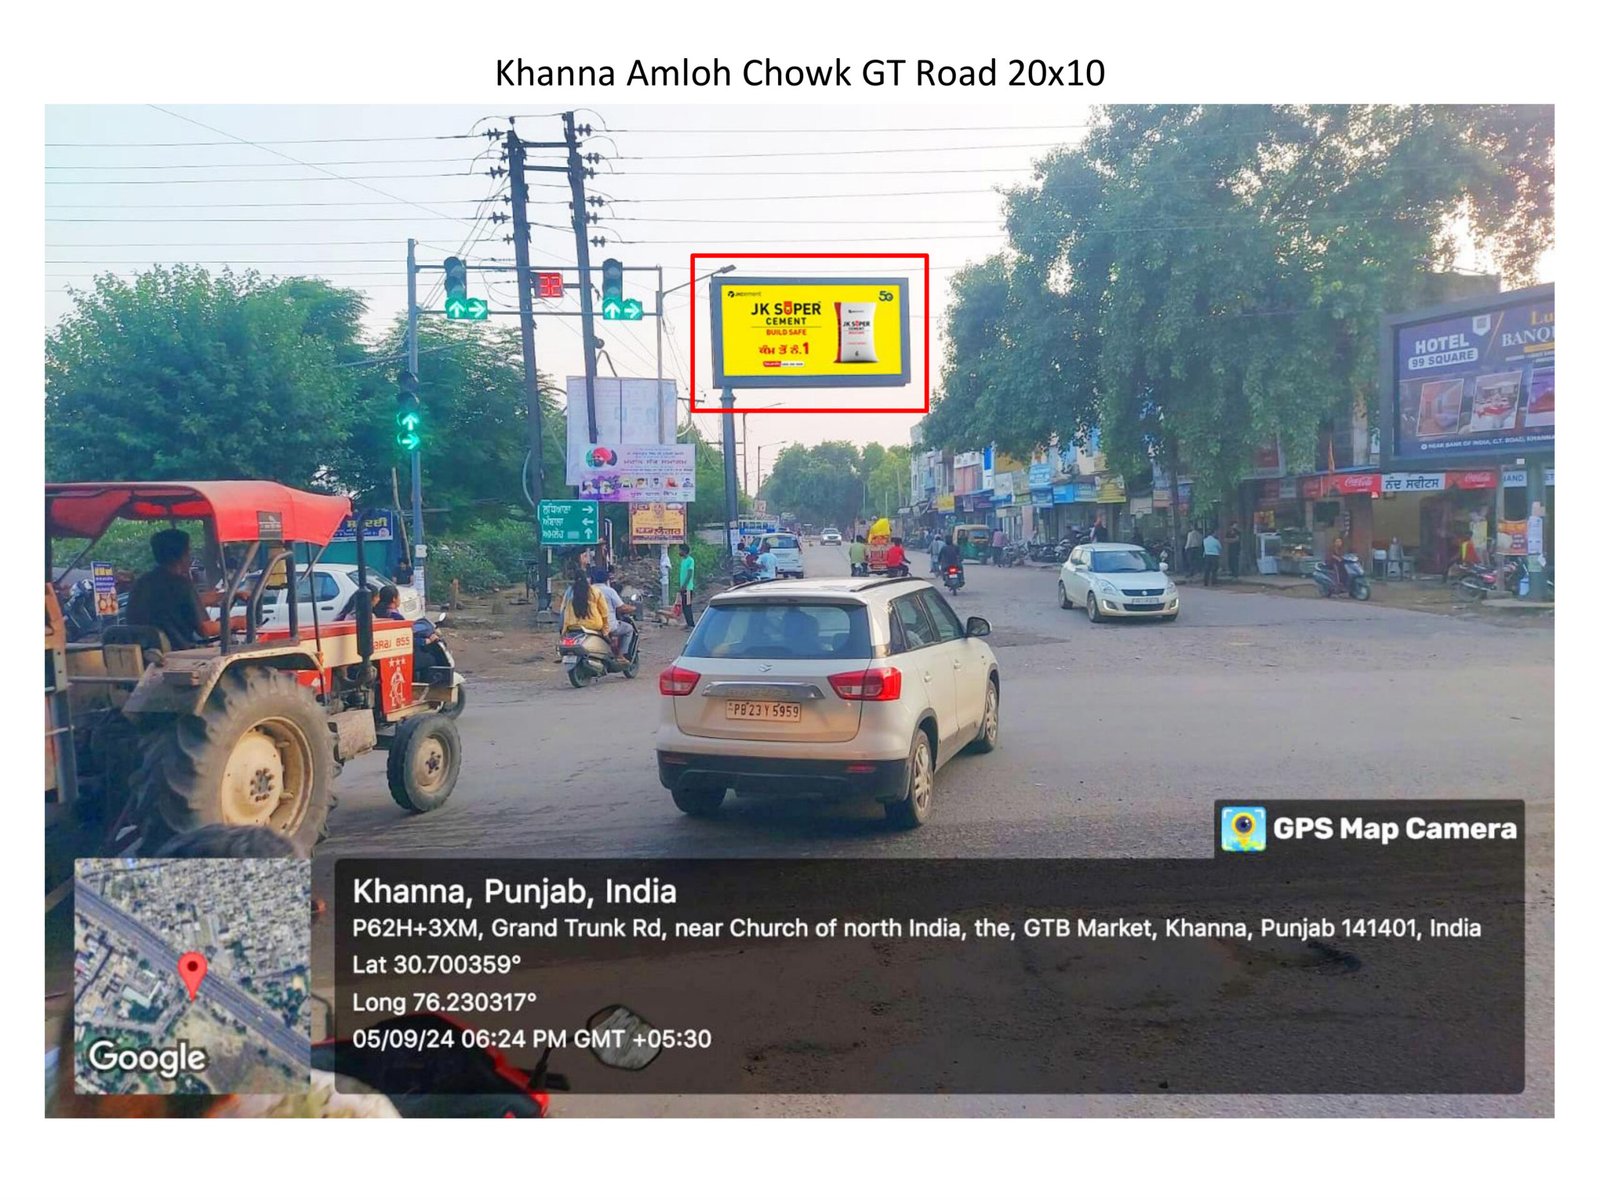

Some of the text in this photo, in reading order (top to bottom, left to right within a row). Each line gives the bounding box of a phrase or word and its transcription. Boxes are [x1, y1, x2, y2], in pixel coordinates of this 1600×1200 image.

[540, 276, 562, 296] 32
[751, 301, 821, 316] JK SUPER
[766, 317, 807, 326] CEMENT
[789, 328, 807, 336] SAFE
[1502, 326, 1554, 347] BANQ
[1415, 333, 1470, 355] HOTEL
[1412, 349, 1474, 368] 99 SQUARE
[1385, 475, 1440, 489] ਨੰਦ ਸਵੀਟਸ
[773, 704, 799, 718] 5959
